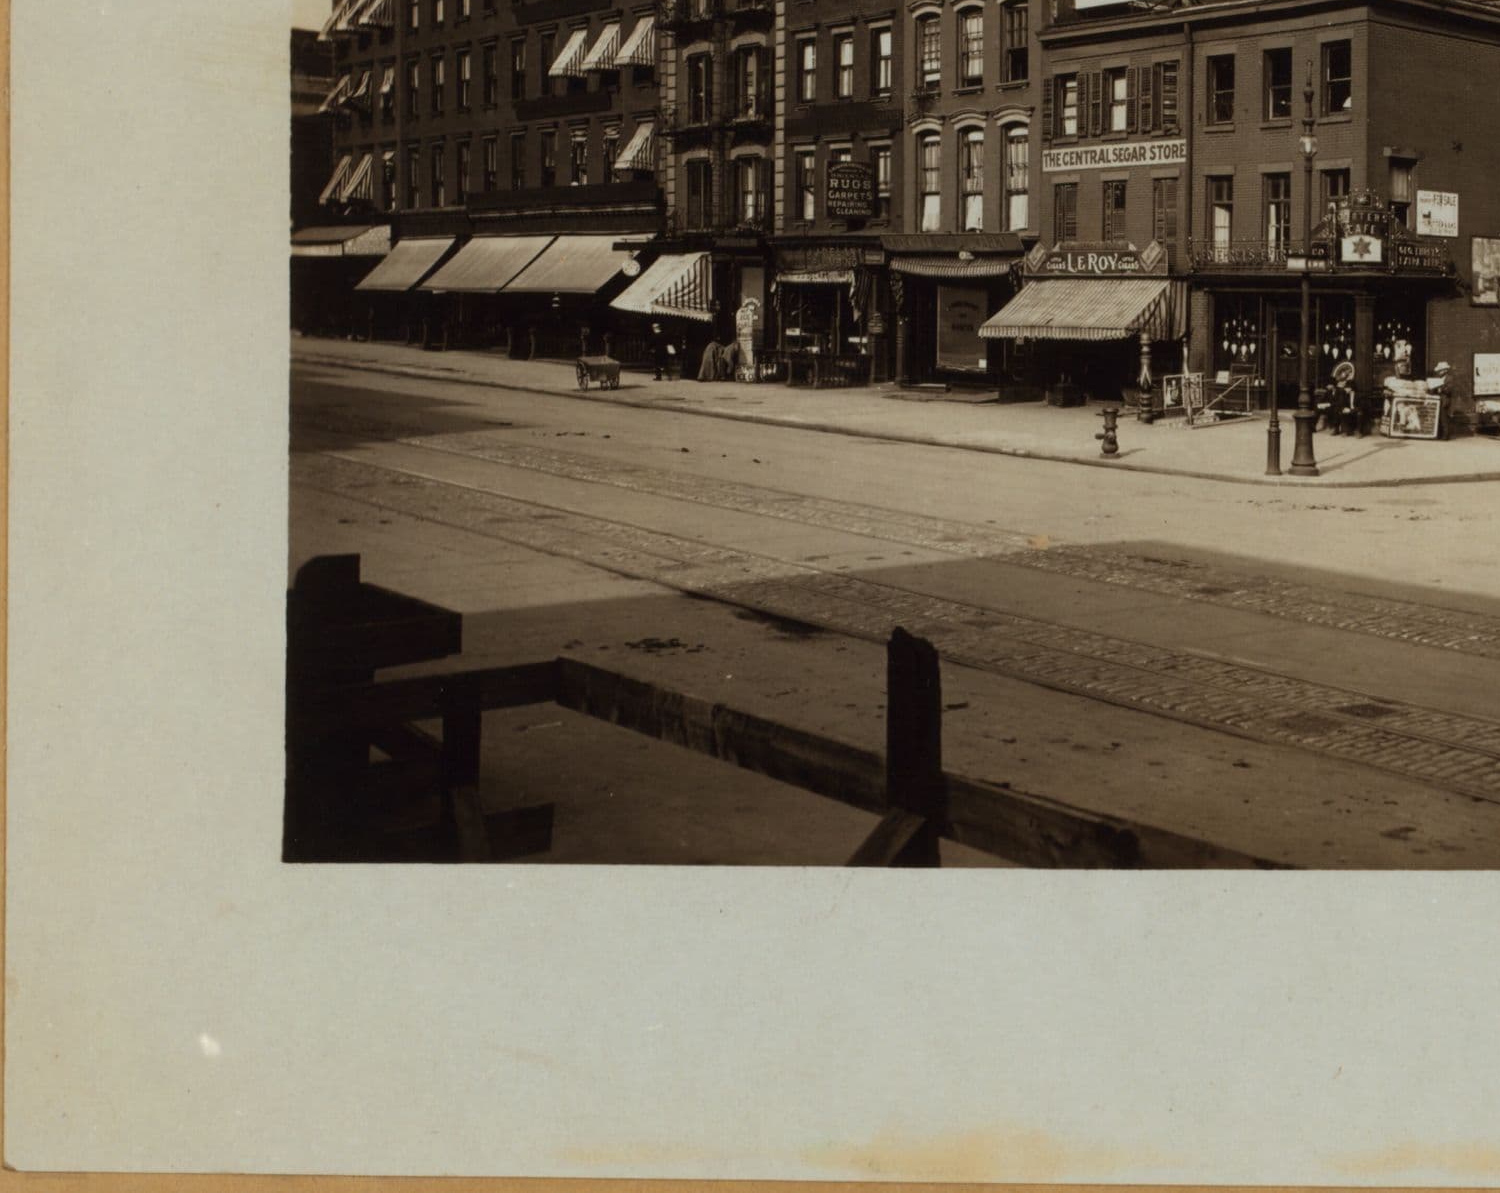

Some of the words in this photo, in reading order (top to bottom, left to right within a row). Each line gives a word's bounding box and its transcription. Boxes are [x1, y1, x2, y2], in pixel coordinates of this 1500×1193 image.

[1044, 152, 1061, 168] THE
[1062, 148, 1112, 166] CENTRAL
[1112, 145, 1147, 163] SEGAR
[1149, 142, 1186, 160] STORE
[829, 178, 871, 190] RUGS
[828, 190, 873, 201] CARPETS
